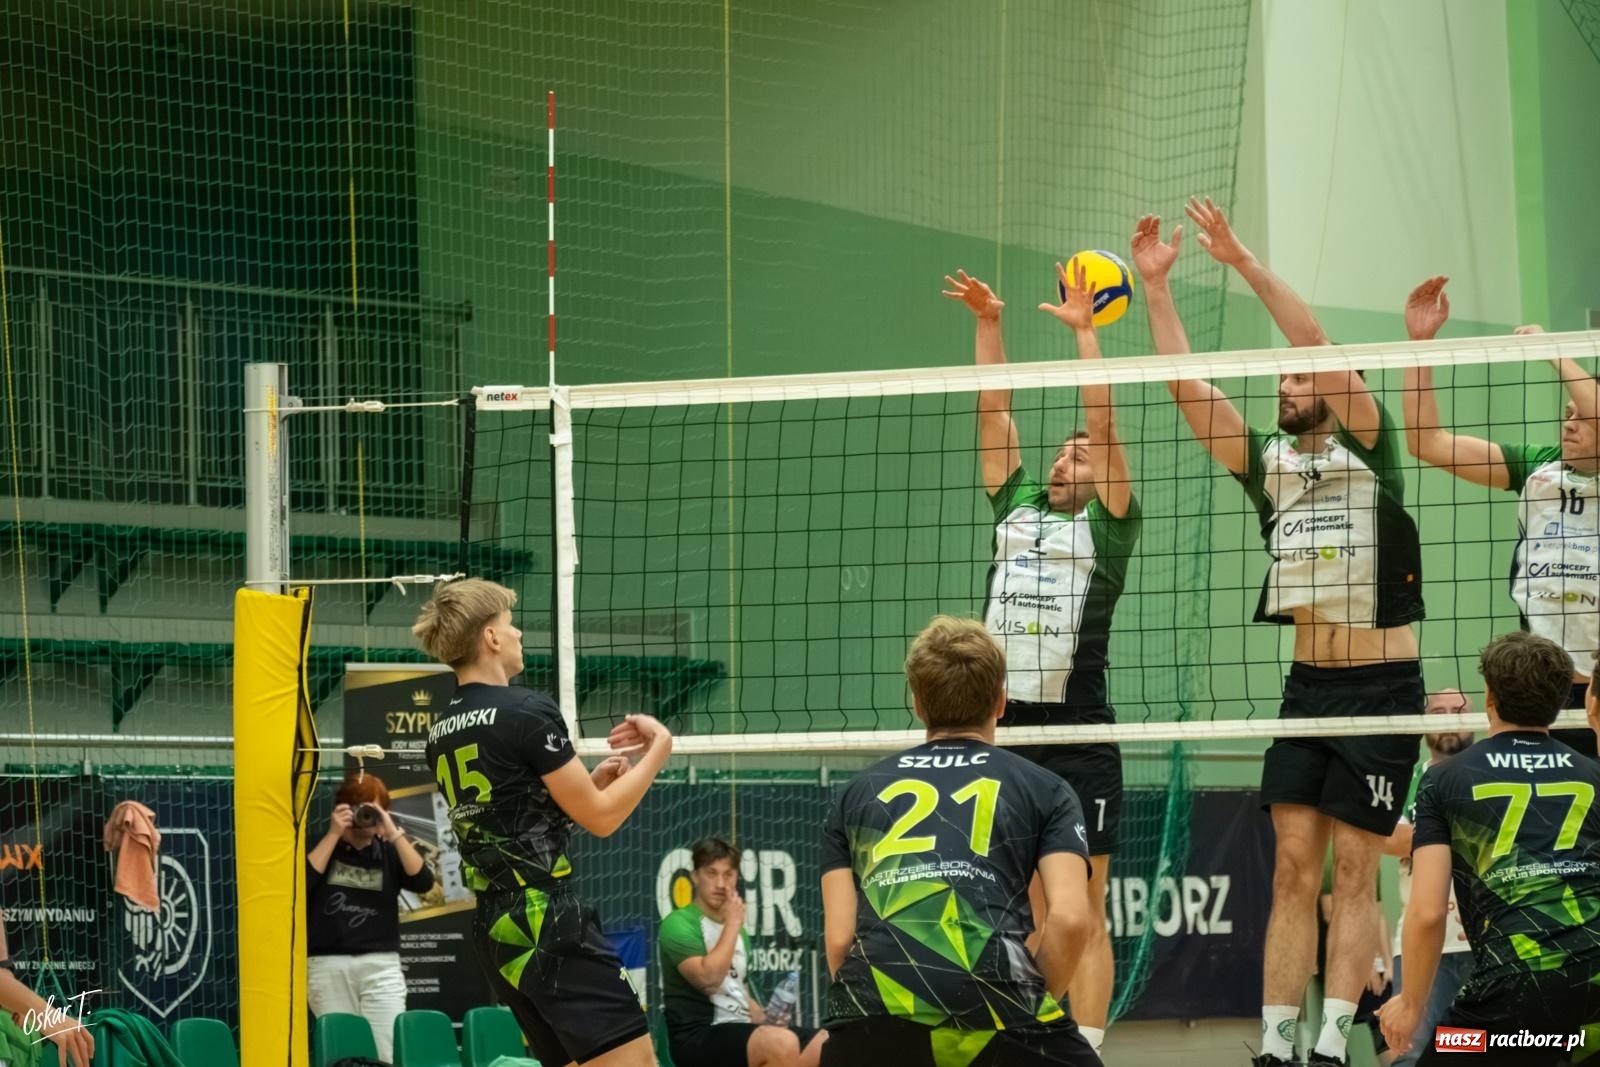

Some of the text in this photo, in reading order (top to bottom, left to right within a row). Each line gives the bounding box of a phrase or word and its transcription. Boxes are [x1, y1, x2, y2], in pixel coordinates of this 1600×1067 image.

[486, 391, 518, 401] netex
[1558, 487, 1585, 515] 16
[1305, 514, 1345, 525] CONCEPT
[1305, 522, 1354, 533] automatic
[1551, 563, 1591, 572] CONCEPT
[1017, 600, 1062, 612] automatic
[1019, 592, 1056, 603] CONCEPT
[385, 711, 441, 734] SZYPU
[897, 752, 991, 769] SZULC
[1485, 752, 1575, 773] WIĘZIK
[436, 742, 493, 810] 15
[1366, 774, 1394, 811] 14
[873, 777, 1001, 863] 21
[1471, 781, 1596, 859] 77
[878, 868, 975, 888] KLUB SPORTOWY
[1501, 866, 1587, 884] KLUB SPORTOWY
[3, 908, 96, 923] SZYM WYDANIU
